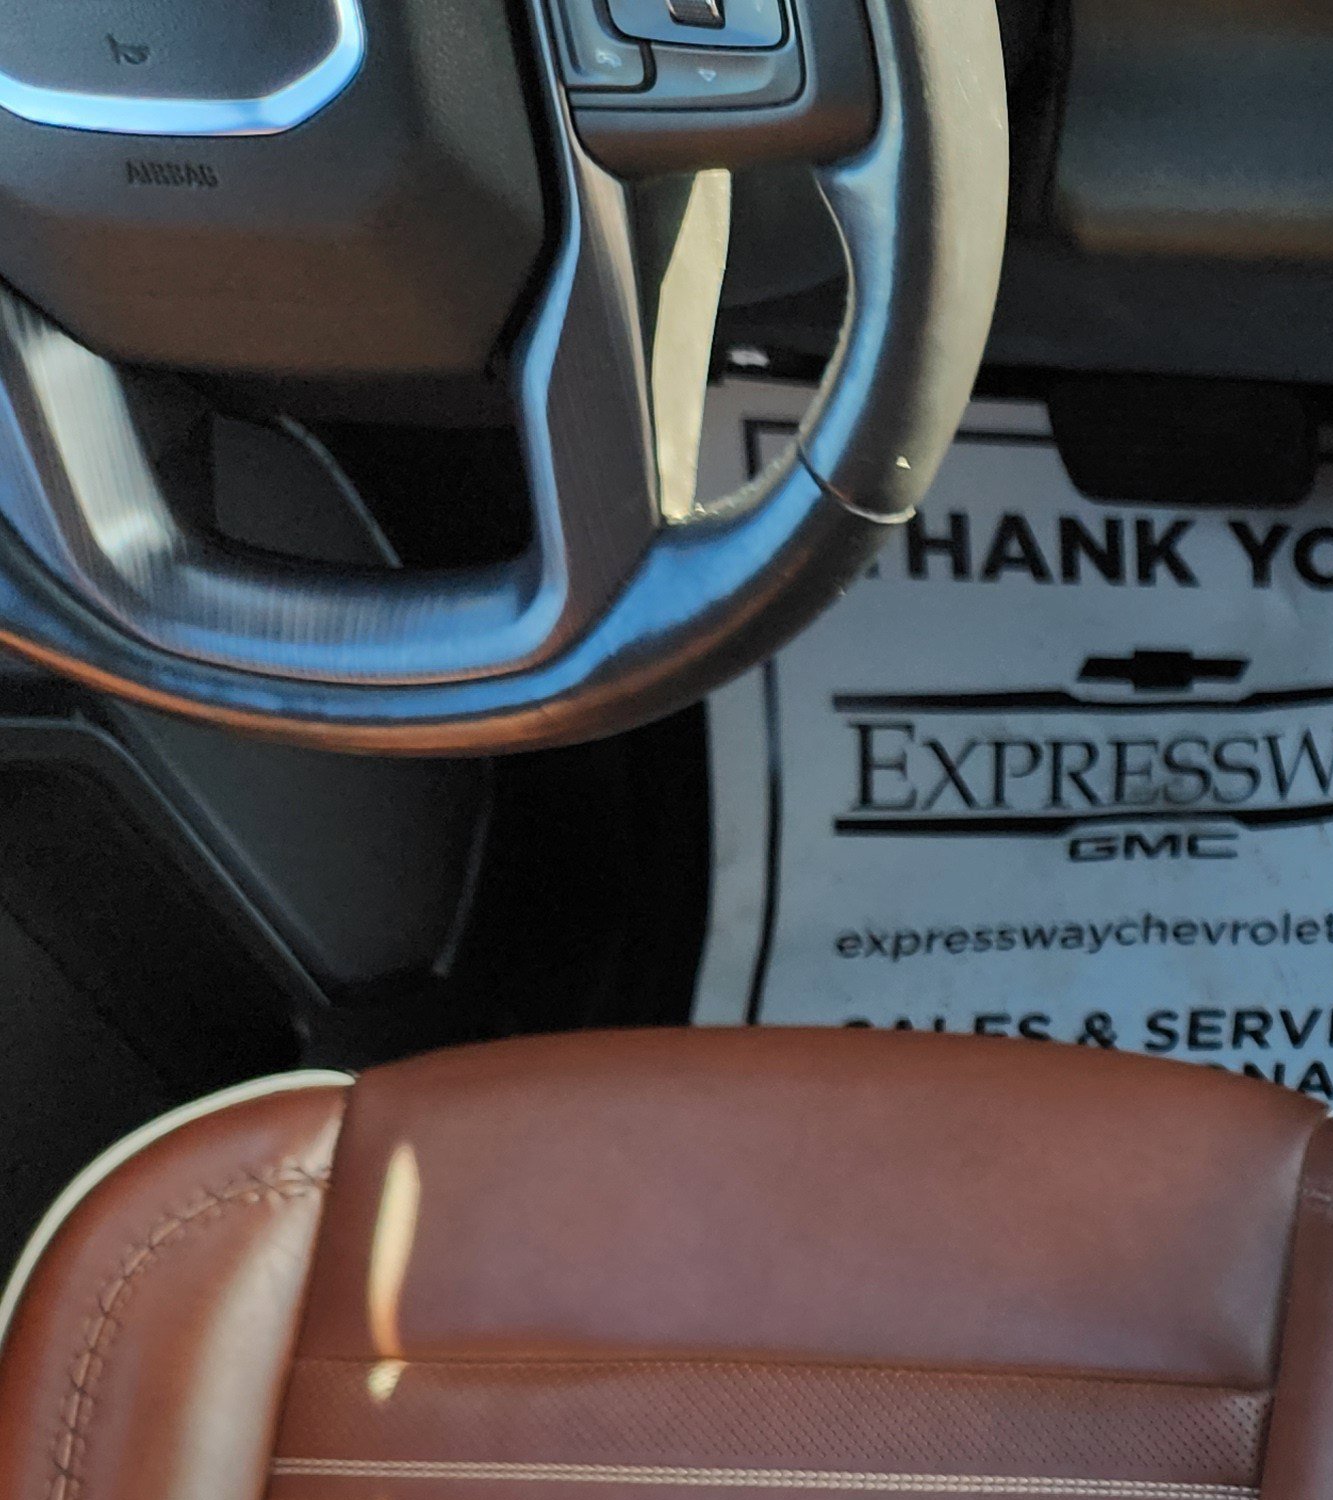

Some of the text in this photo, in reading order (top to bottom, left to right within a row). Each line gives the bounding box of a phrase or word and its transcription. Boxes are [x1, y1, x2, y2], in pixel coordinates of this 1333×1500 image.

[126, 161, 218, 187] AIRBAG
[866, 512, 1200, 588] HANK
[1067, 829, 1240, 863] GMC
